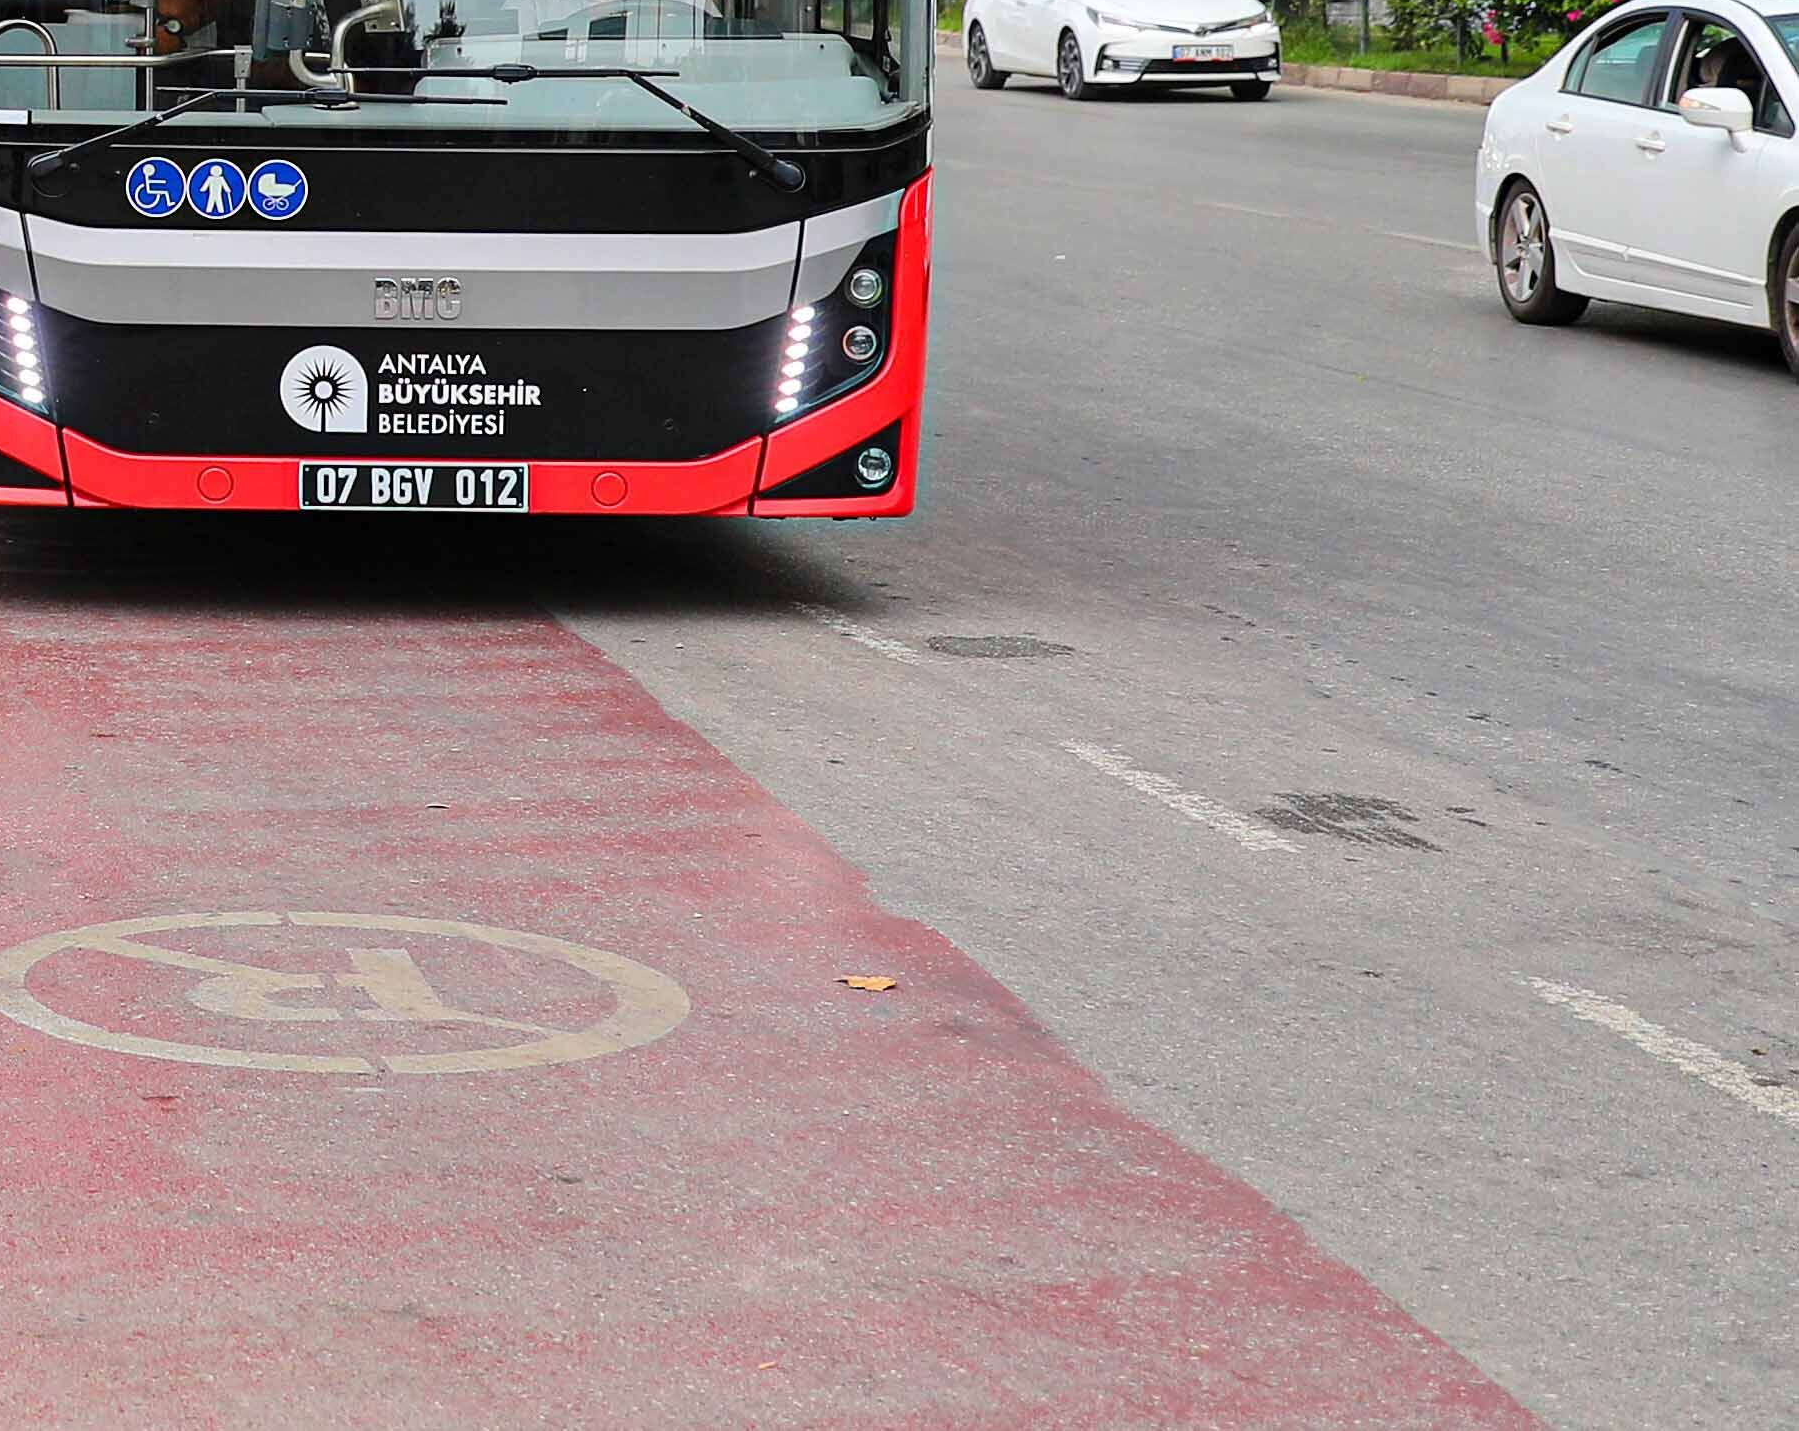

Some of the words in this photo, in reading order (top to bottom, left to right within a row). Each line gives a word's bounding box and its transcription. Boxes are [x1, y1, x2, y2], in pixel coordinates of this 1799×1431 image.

[373, 277, 462, 321] BMC
[377, 353, 487, 375] ANTALYA
[377, 408, 505, 435] BELEDİYESİ
[316, 467, 358, 504] 07
[371, 467, 434, 506] BGV
[455, 468, 519, 507] 012
